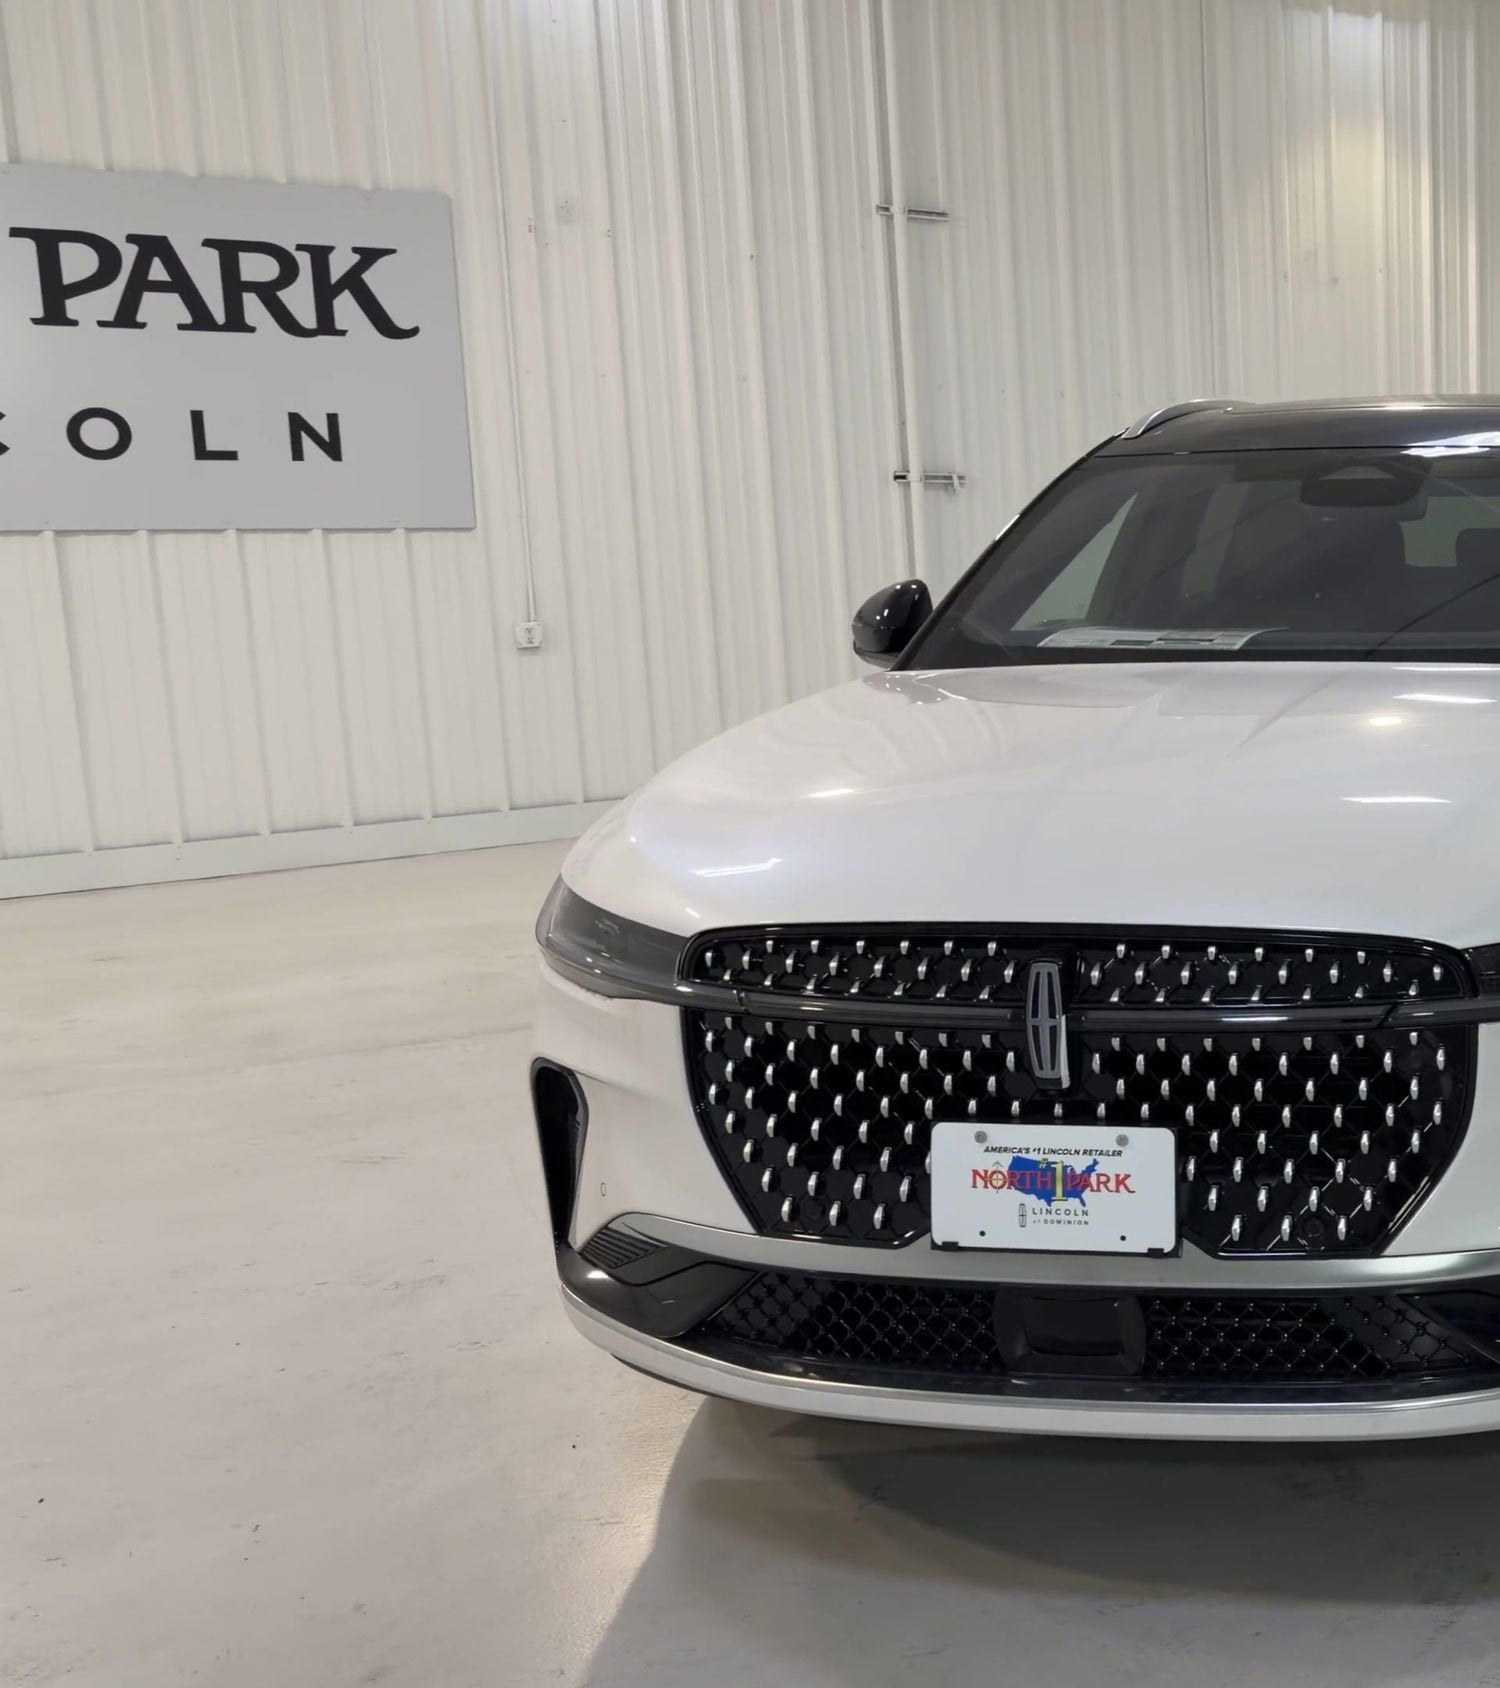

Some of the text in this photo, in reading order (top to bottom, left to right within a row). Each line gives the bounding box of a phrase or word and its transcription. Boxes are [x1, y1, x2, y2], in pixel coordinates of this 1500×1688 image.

[9, 226, 420, 340] PARK
[0, 407, 343, 462] OLN
[984, 1146, 1031, 1154] AMERICA'S
[1042, 1147, 1080, 1156] LINCOLN
[1082, 1149, 1123, 1157] RETAILER
[971, 1169, 1136, 1194] NORTH PARK
[1032, 1207, 1089, 1217] LINCOLN
